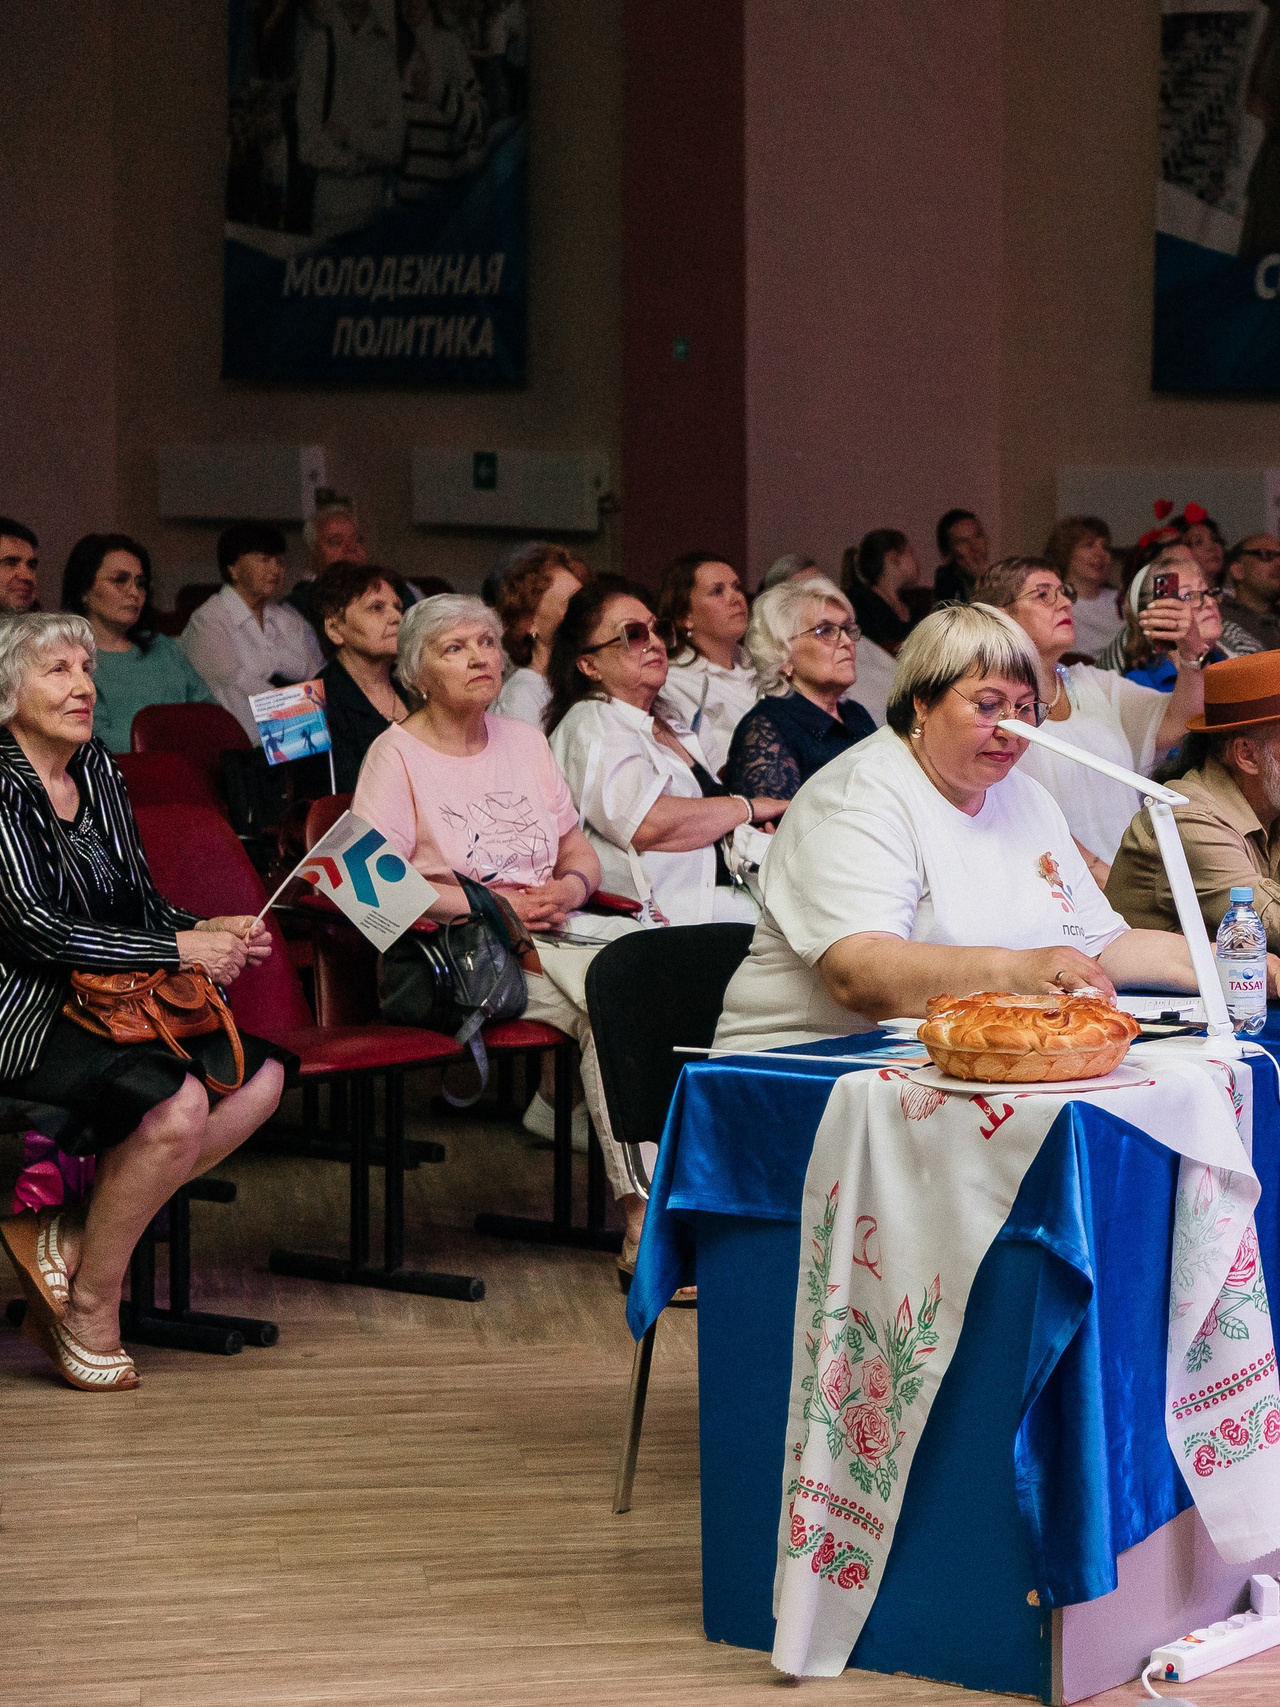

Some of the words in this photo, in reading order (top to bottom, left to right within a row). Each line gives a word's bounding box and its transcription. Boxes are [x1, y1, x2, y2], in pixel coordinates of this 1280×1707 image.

[282, 253, 505, 302] МОЛОДЕЖНАЯ
[332, 315, 495, 357] ПОЛИТИКА
[1228, 980, 1264, 991] TASSAY
